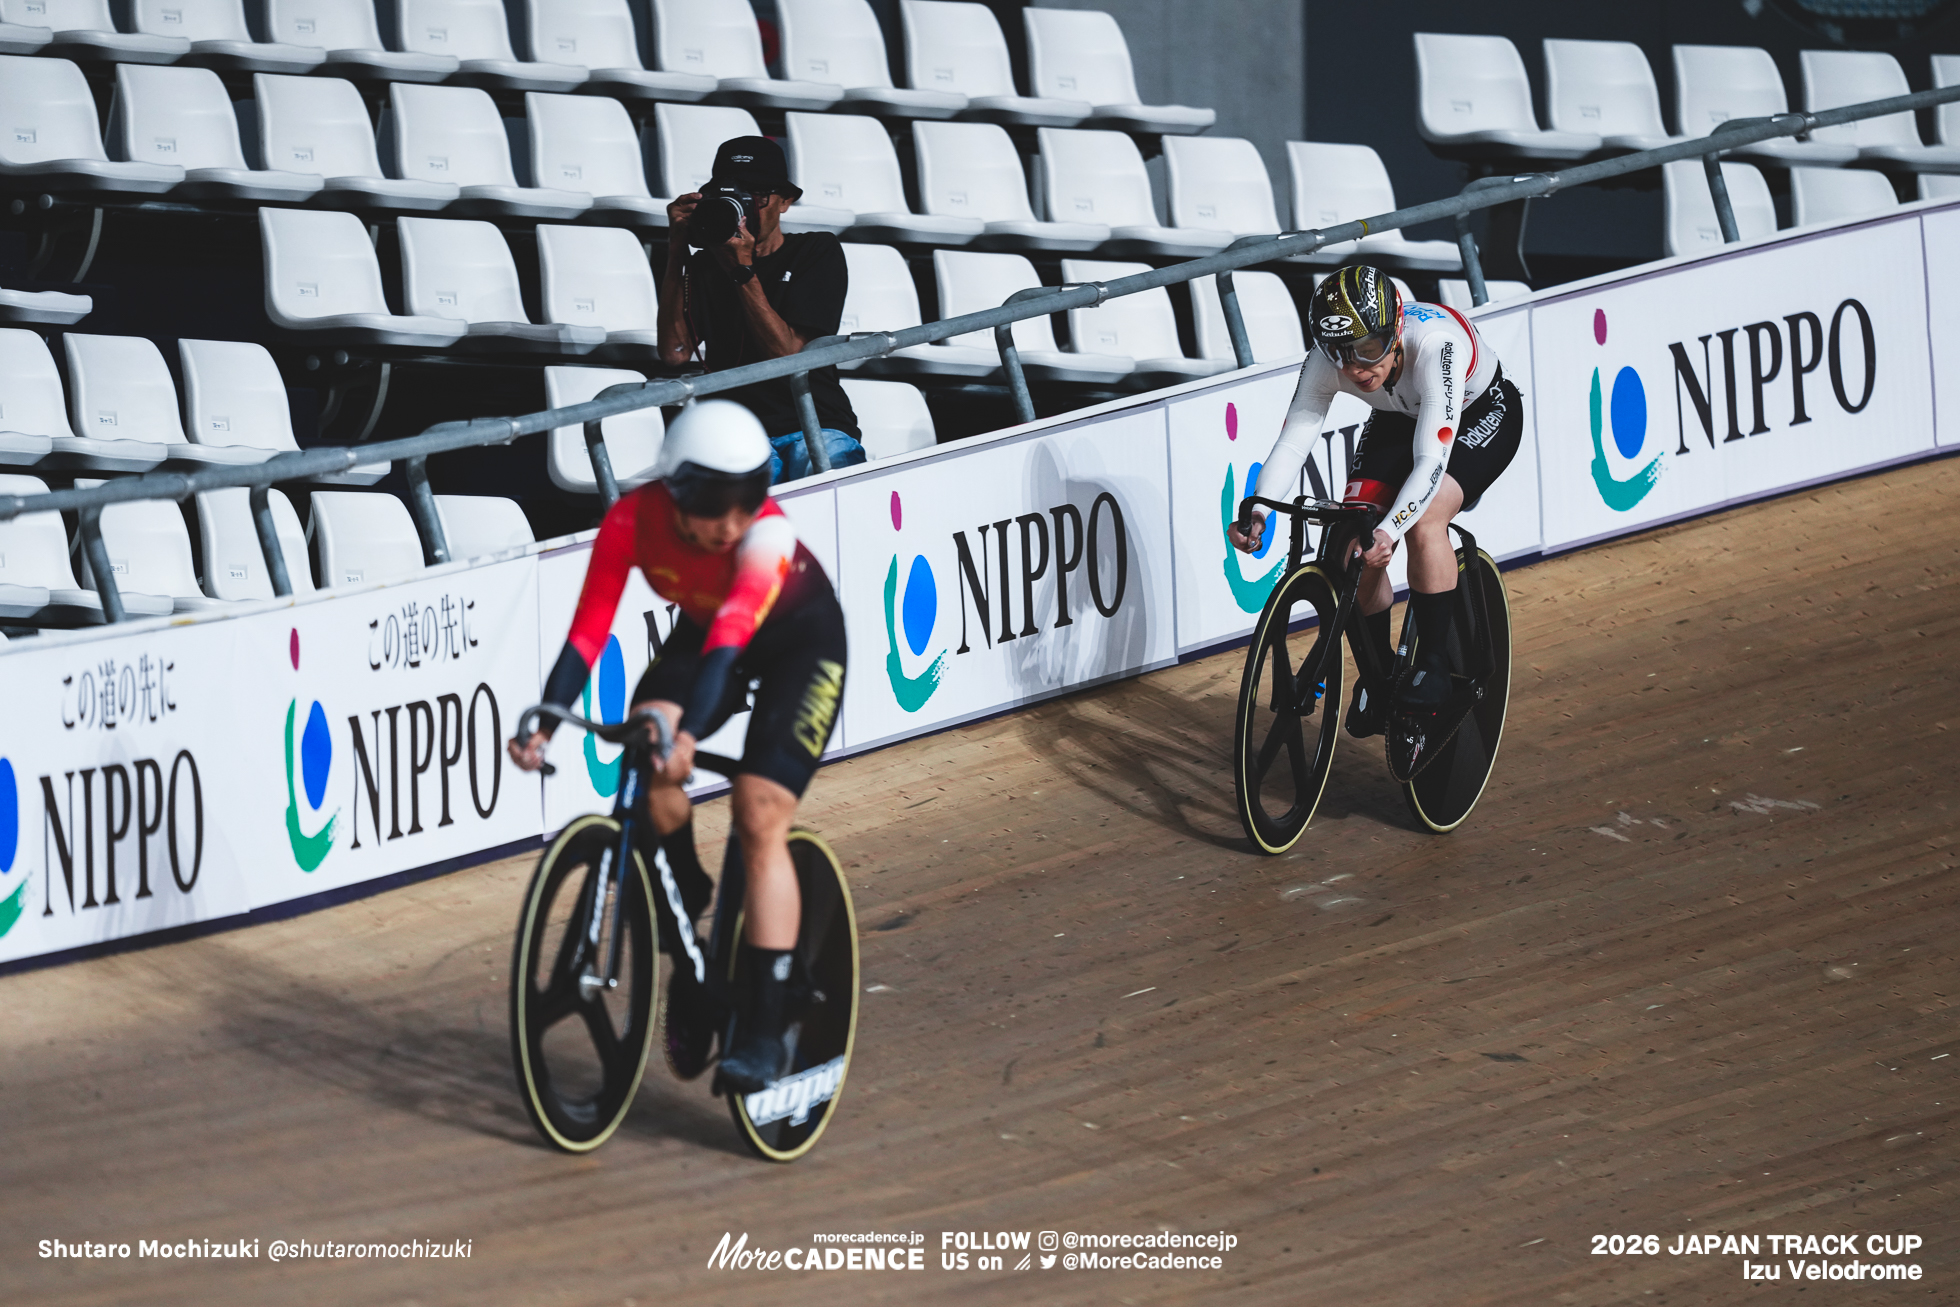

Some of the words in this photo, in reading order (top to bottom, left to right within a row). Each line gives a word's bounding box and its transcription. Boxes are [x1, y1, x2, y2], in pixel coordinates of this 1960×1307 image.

[1321, 329, 1354, 338] Kabuto
[1442, 341, 1454, 376] Rakuten
[1668, 298, 1876, 456] NIPPO
[952, 491, 1127, 655] NIPPO
[368, 594, 478, 671] この道の先に
[61, 653, 176, 730] この道の先に
[348, 682, 502, 850] NIPPO
[39, 749, 204, 917] NIPPO
